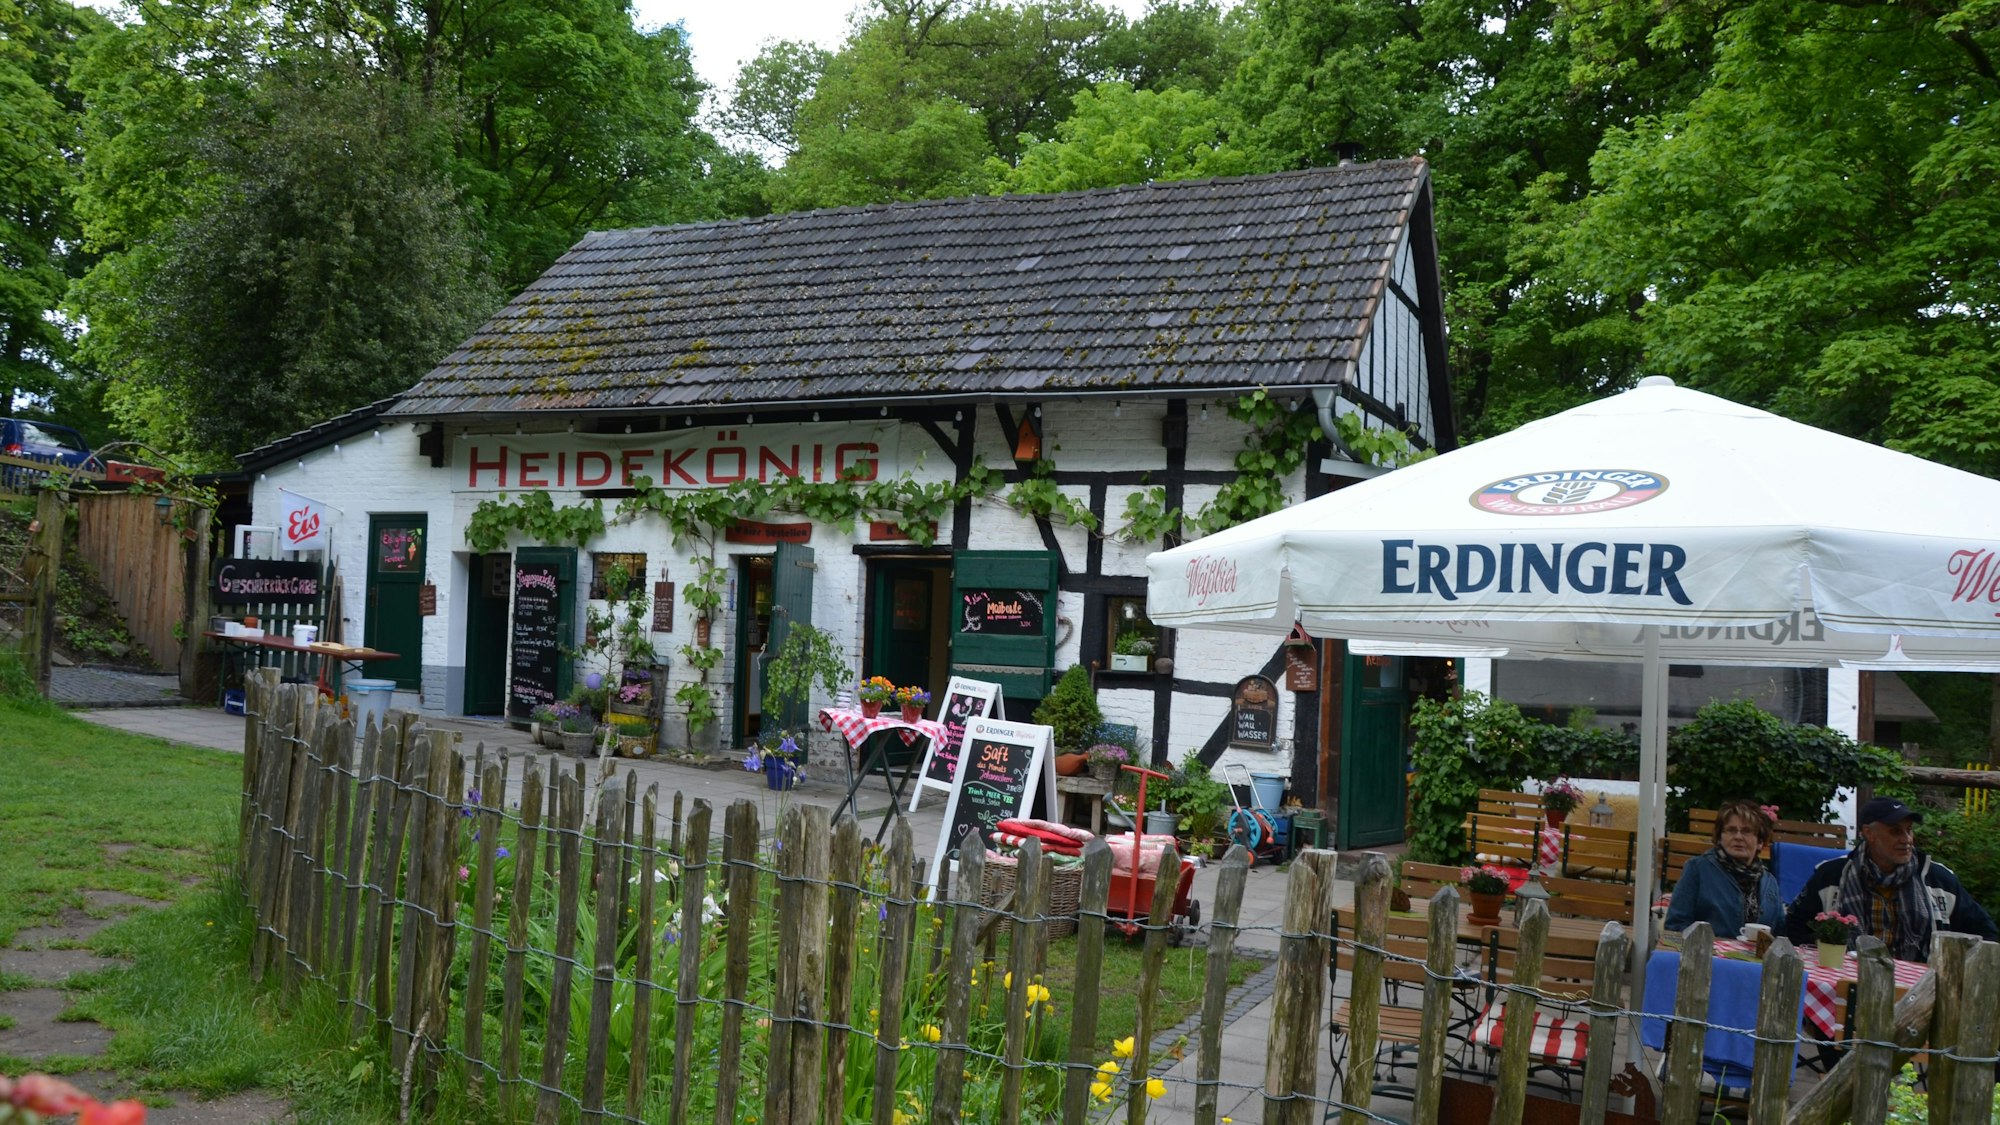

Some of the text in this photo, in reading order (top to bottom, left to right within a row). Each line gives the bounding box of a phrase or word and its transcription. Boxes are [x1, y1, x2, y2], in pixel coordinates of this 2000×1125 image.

[468, 430, 880, 488] HEIDEKÖNIG
[1494, 471, 1656, 491] ERDINGER
[1489, 495, 1640, 515] WEISSBRÄU
[287, 505, 320, 543] Eis
[1186, 555, 1237, 606] Weißbier
[1380, 539, 1694, 606] ERDINGER
[987, 601, 1023, 614] Maibowle
[1238, 712, 1255, 720] WAU
[1238, 721, 1255, 729] WAU
[986, 726, 1014, 738] ERDINGER
[1238, 731, 1268, 740] WASSER
[981, 744, 1009, 765] Saft
[976, 761, 986, 769] das
[967, 786, 984, 796] Trink
[1003, 794, 1014, 804] TEE
